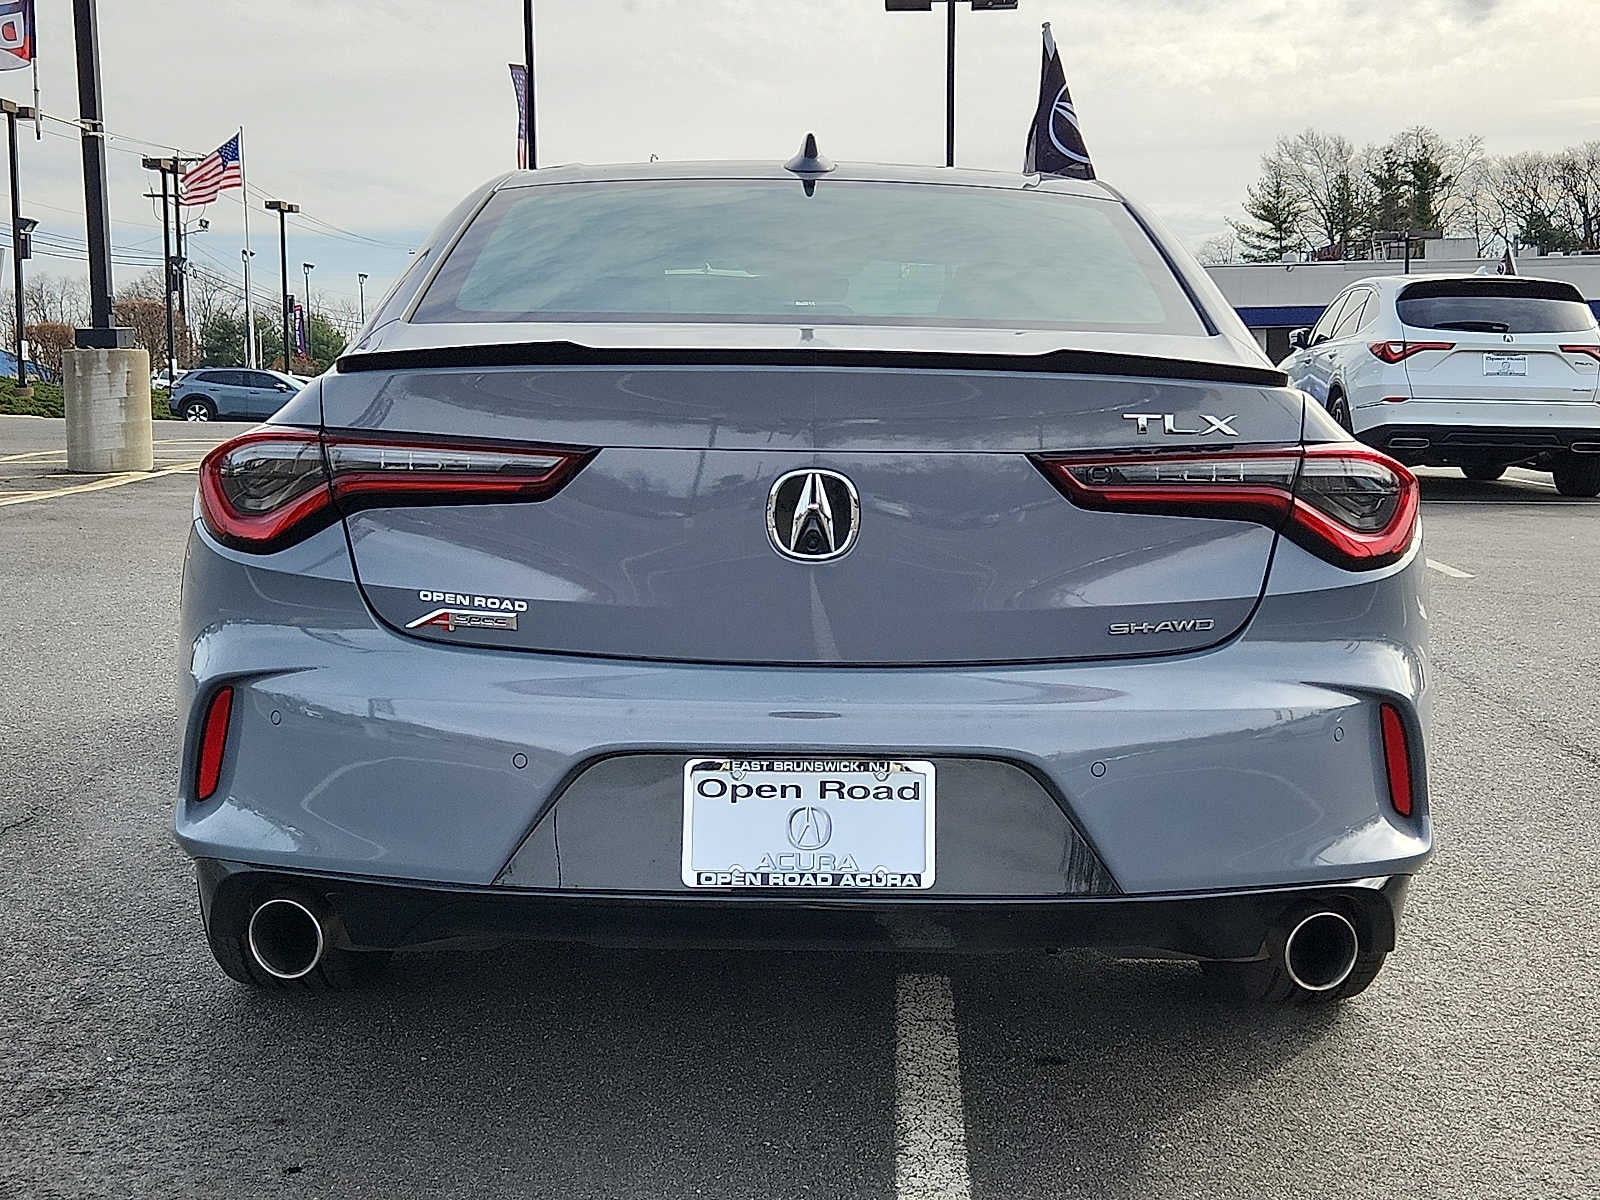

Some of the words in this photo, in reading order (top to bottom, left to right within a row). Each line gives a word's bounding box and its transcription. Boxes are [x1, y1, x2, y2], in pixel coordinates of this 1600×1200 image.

[1122, 413, 1239, 436] TLX
[420, 590, 470, 606] OPEN
[474, 597, 528, 611] ROAD
[1109, 619, 1215, 634] SH-AWD
[732, 760, 770, 772] EAST
[773, 761, 865, 773] BRUNSWICK,
[869, 761, 888, 773] NJ
[697, 778, 801, 803] Open
[819, 780, 920, 801] Road
[755, 852, 860, 872] ACURA
[700, 872, 762, 886] OPEN
[769, 873, 833, 887] ROAD
[839, 873, 919, 887] ACURA
